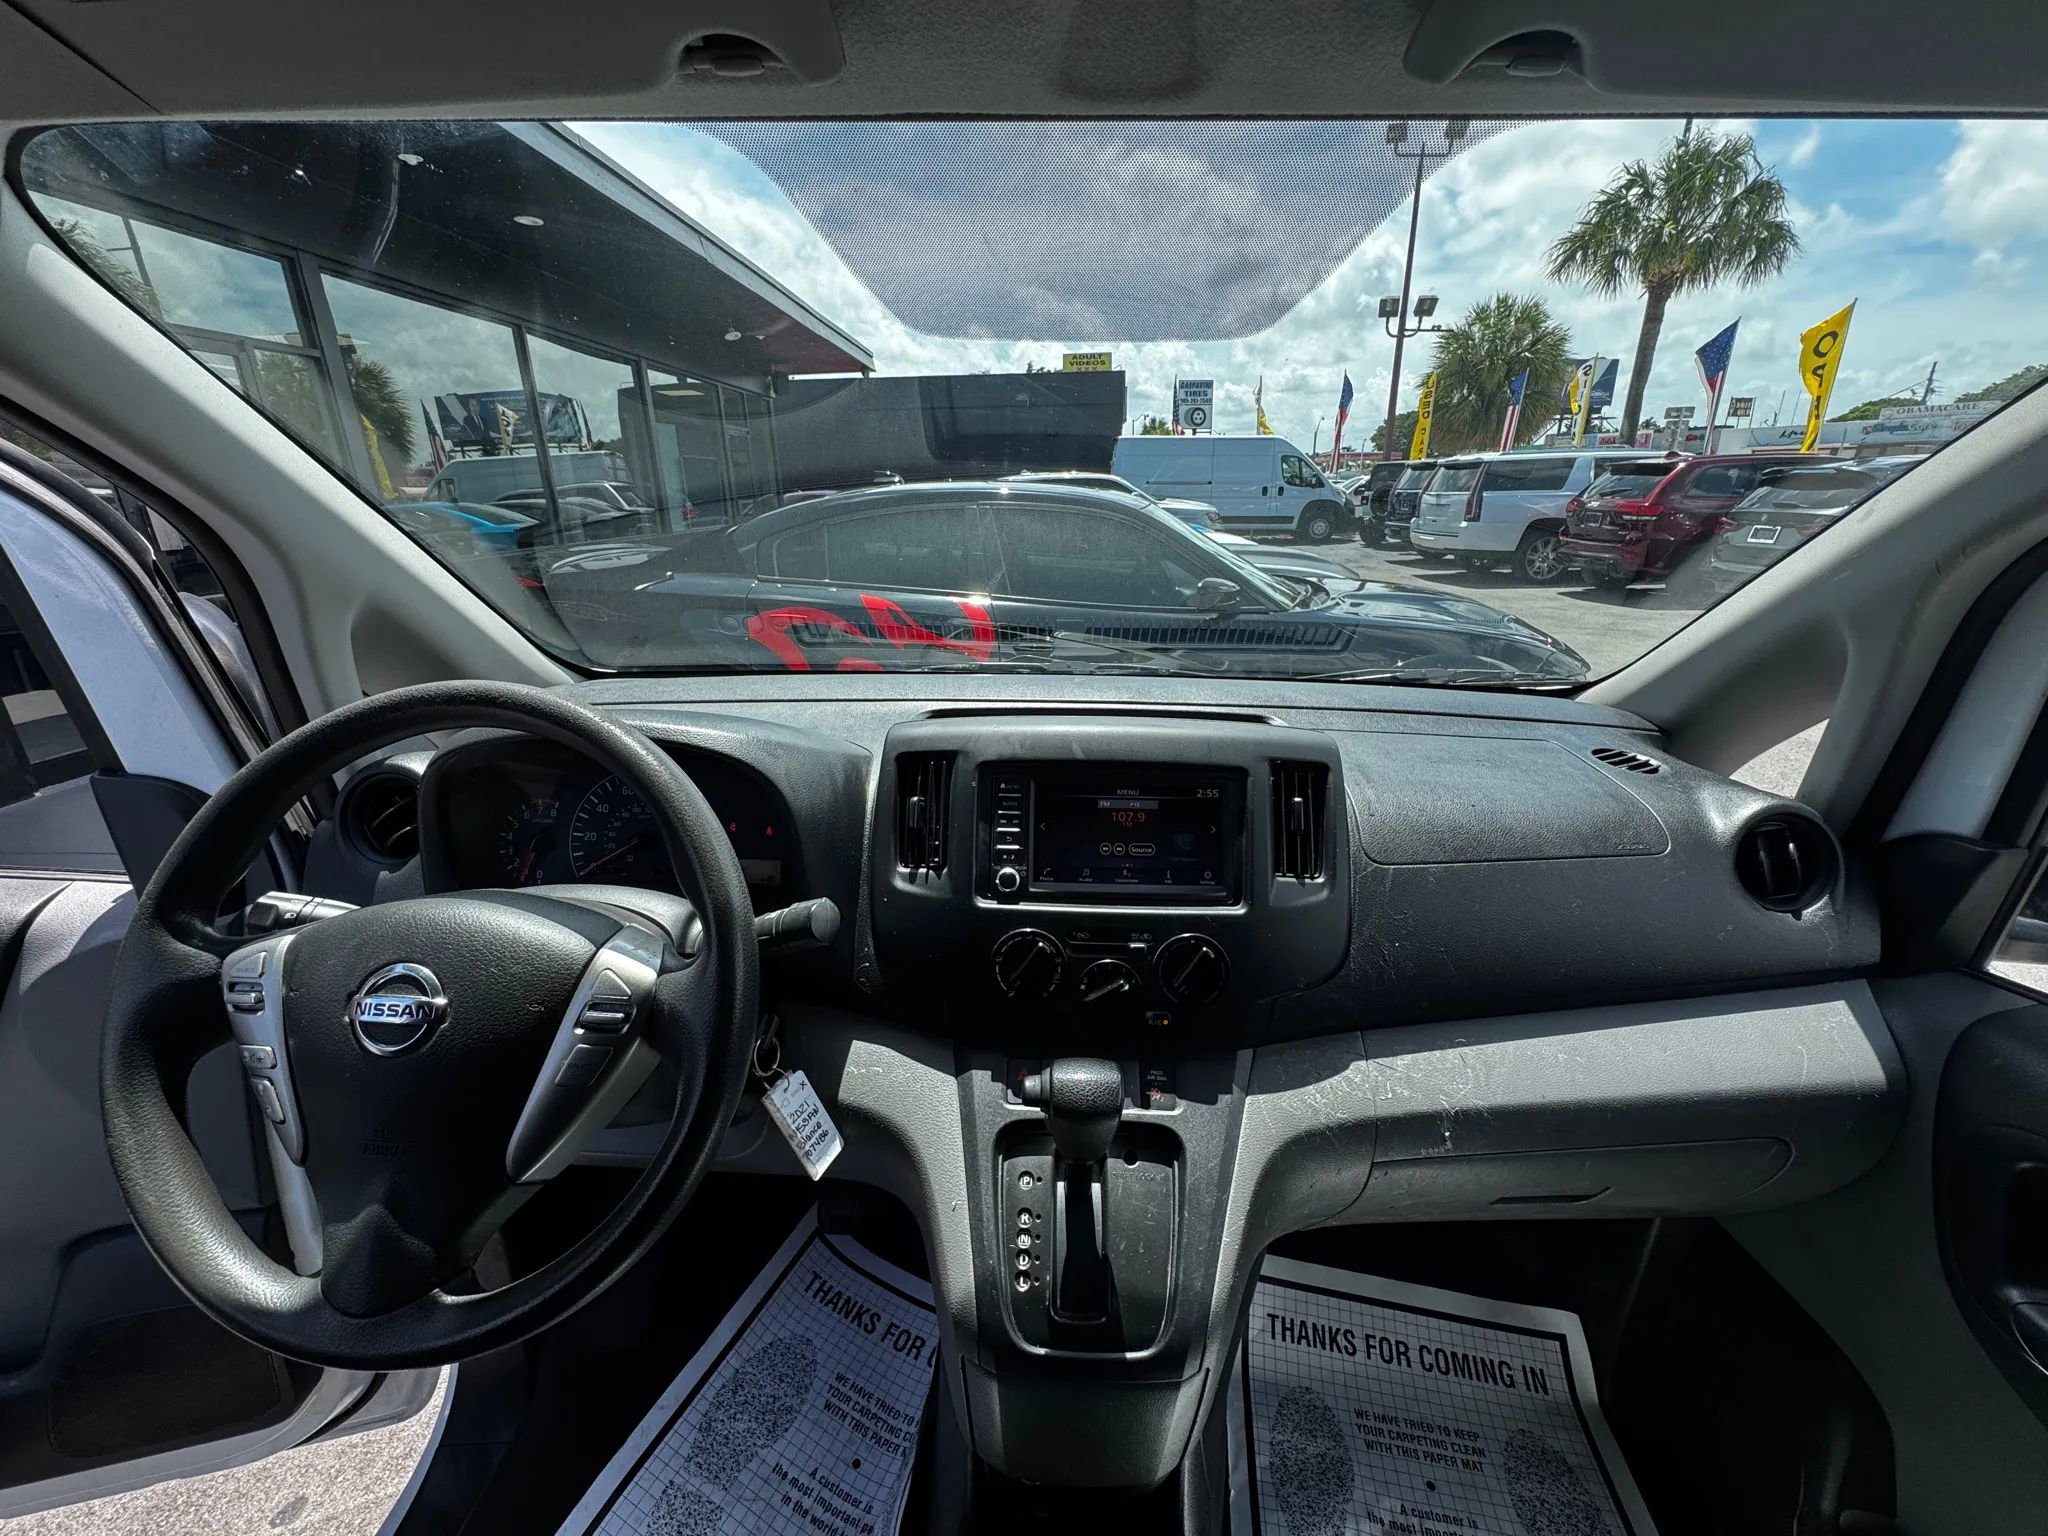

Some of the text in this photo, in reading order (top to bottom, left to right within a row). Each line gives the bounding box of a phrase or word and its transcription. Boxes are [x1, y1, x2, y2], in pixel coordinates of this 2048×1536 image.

[1184, 390, 1208, 398] TIRES
[1895, 403, 1981, 415] OBAMACARE
[1196, 788, 1219, 798] 2:55
[596, 803, 608, 812] 40
[1111, 811, 1145, 822] 107.9
[584, 832, 596, 841] 20
[355, 1001, 435, 1019] NISSAN
[789, 1100, 810, 1124] 2021
[803, 1270, 881, 1335] THANKS
[880, 1322, 926, 1361] FOR
[1266, 1313, 1549, 1396] THANKS FOR COMING IN
[827, 1384, 851, 1408] YOUR
[852, 1401, 903, 1439] CARPETING
[835, 1373, 849, 1387] WE
[849, 1382, 873, 1403] HAVE
[874, 1397, 901, 1421] TRIED
[902, 1413, 915, 1427] TO
[823, 1399, 849, 1421] WITH
[848, 1415, 869, 1437] THIS
[870, 1432, 903, 1454] PAPER
[1354, 1408, 1480, 1442] WE HAVE TRIED TO KEEP
[1355, 1423, 1487, 1458] YOUR CARPETING CLEAN
[1364, 1438, 1484, 1473] WITH THIS PAPER MAT
[772, 1462, 788, 1480] the
[789, 1475, 813, 1499] most
[814, 1491, 861, 1529] important
[809, 1467, 874, 1514] A customer is
[780, 1491, 792, 1507] in
[792, 1498, 809, 1519] the
[1400, 1503, 1479, 1529] A customer is
[1368, 1511, 1385, 1527] the
[1389, 1520, 1417, 1535] most
